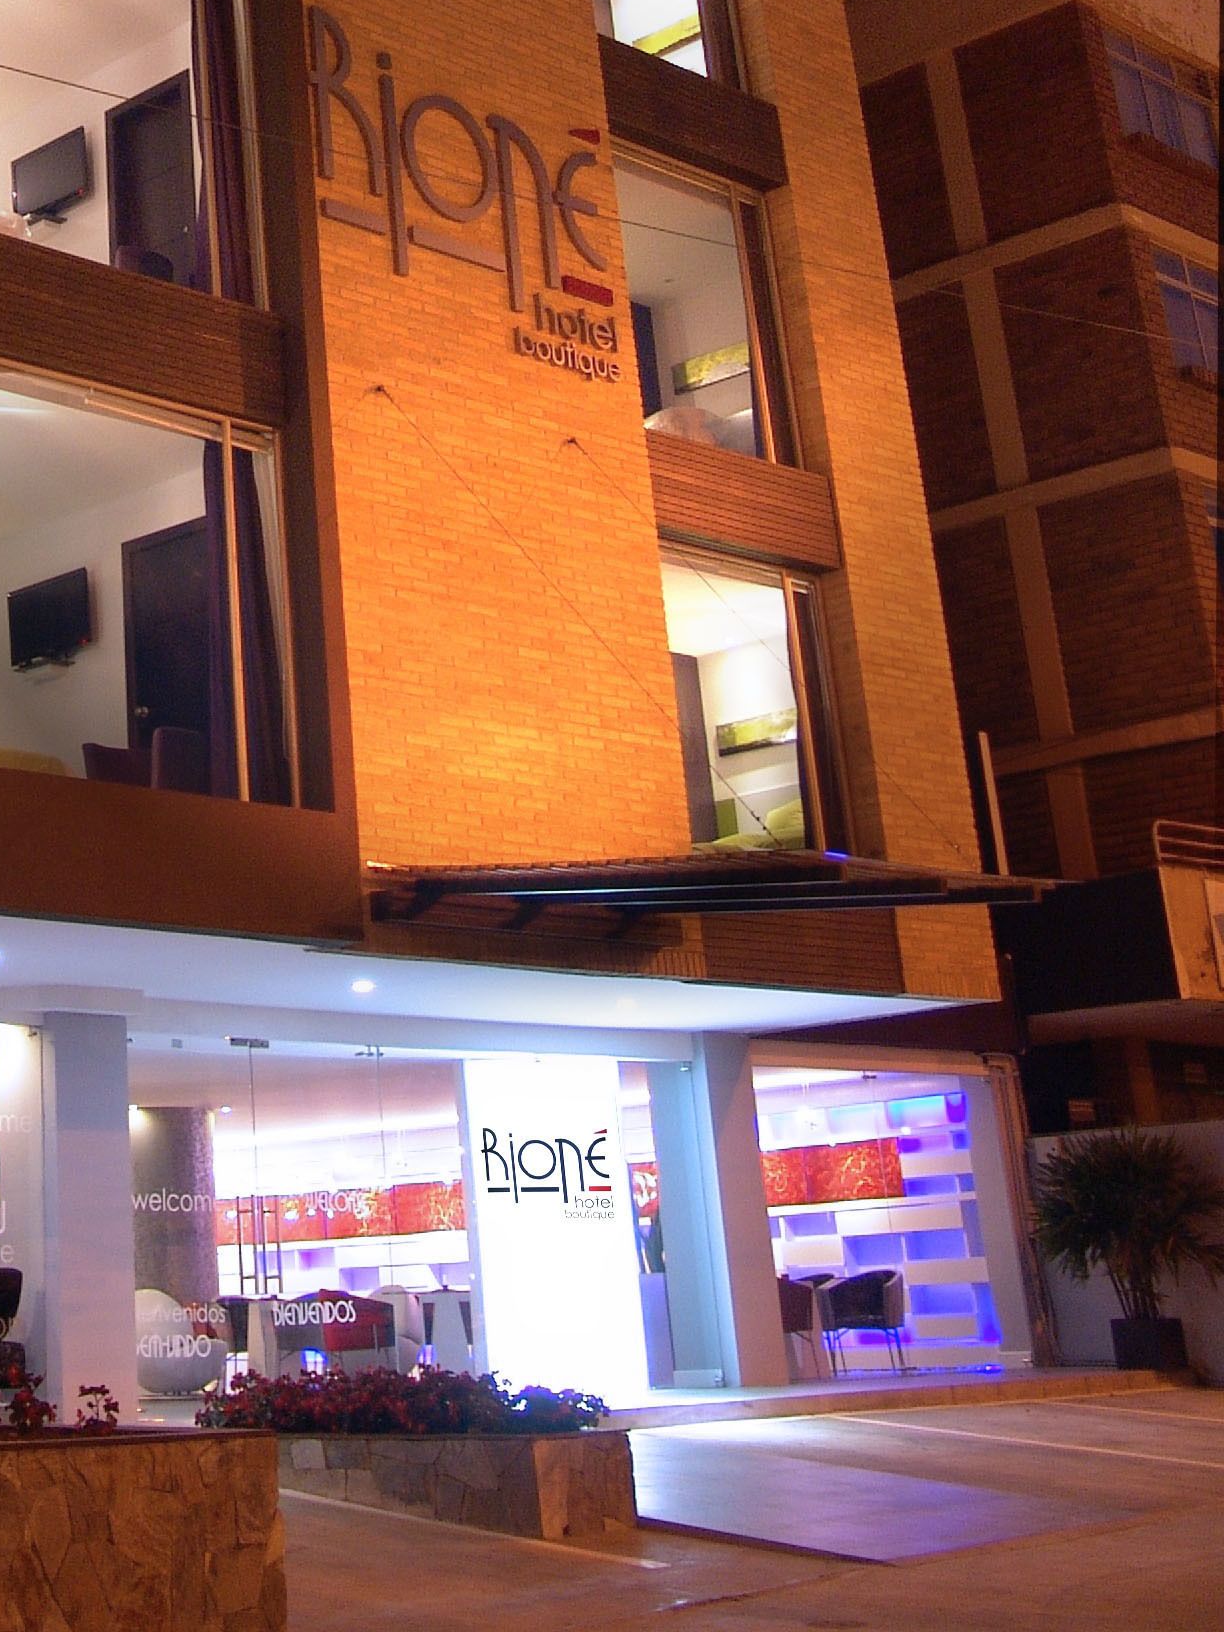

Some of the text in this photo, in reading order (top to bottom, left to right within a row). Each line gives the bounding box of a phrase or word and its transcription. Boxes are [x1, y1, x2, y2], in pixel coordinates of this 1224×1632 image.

[309, 6, 607, 314] Rioné
[533, 292, 617, 353] hotel
[513, 326, 621, 383] boutique
[481, 1128, 610, 1204] Rioné
[131, 1188, 213, 1212] welcom
[564, 1210, 615, 1220] boutique
[574, 1195, 614, 1209] hotel
